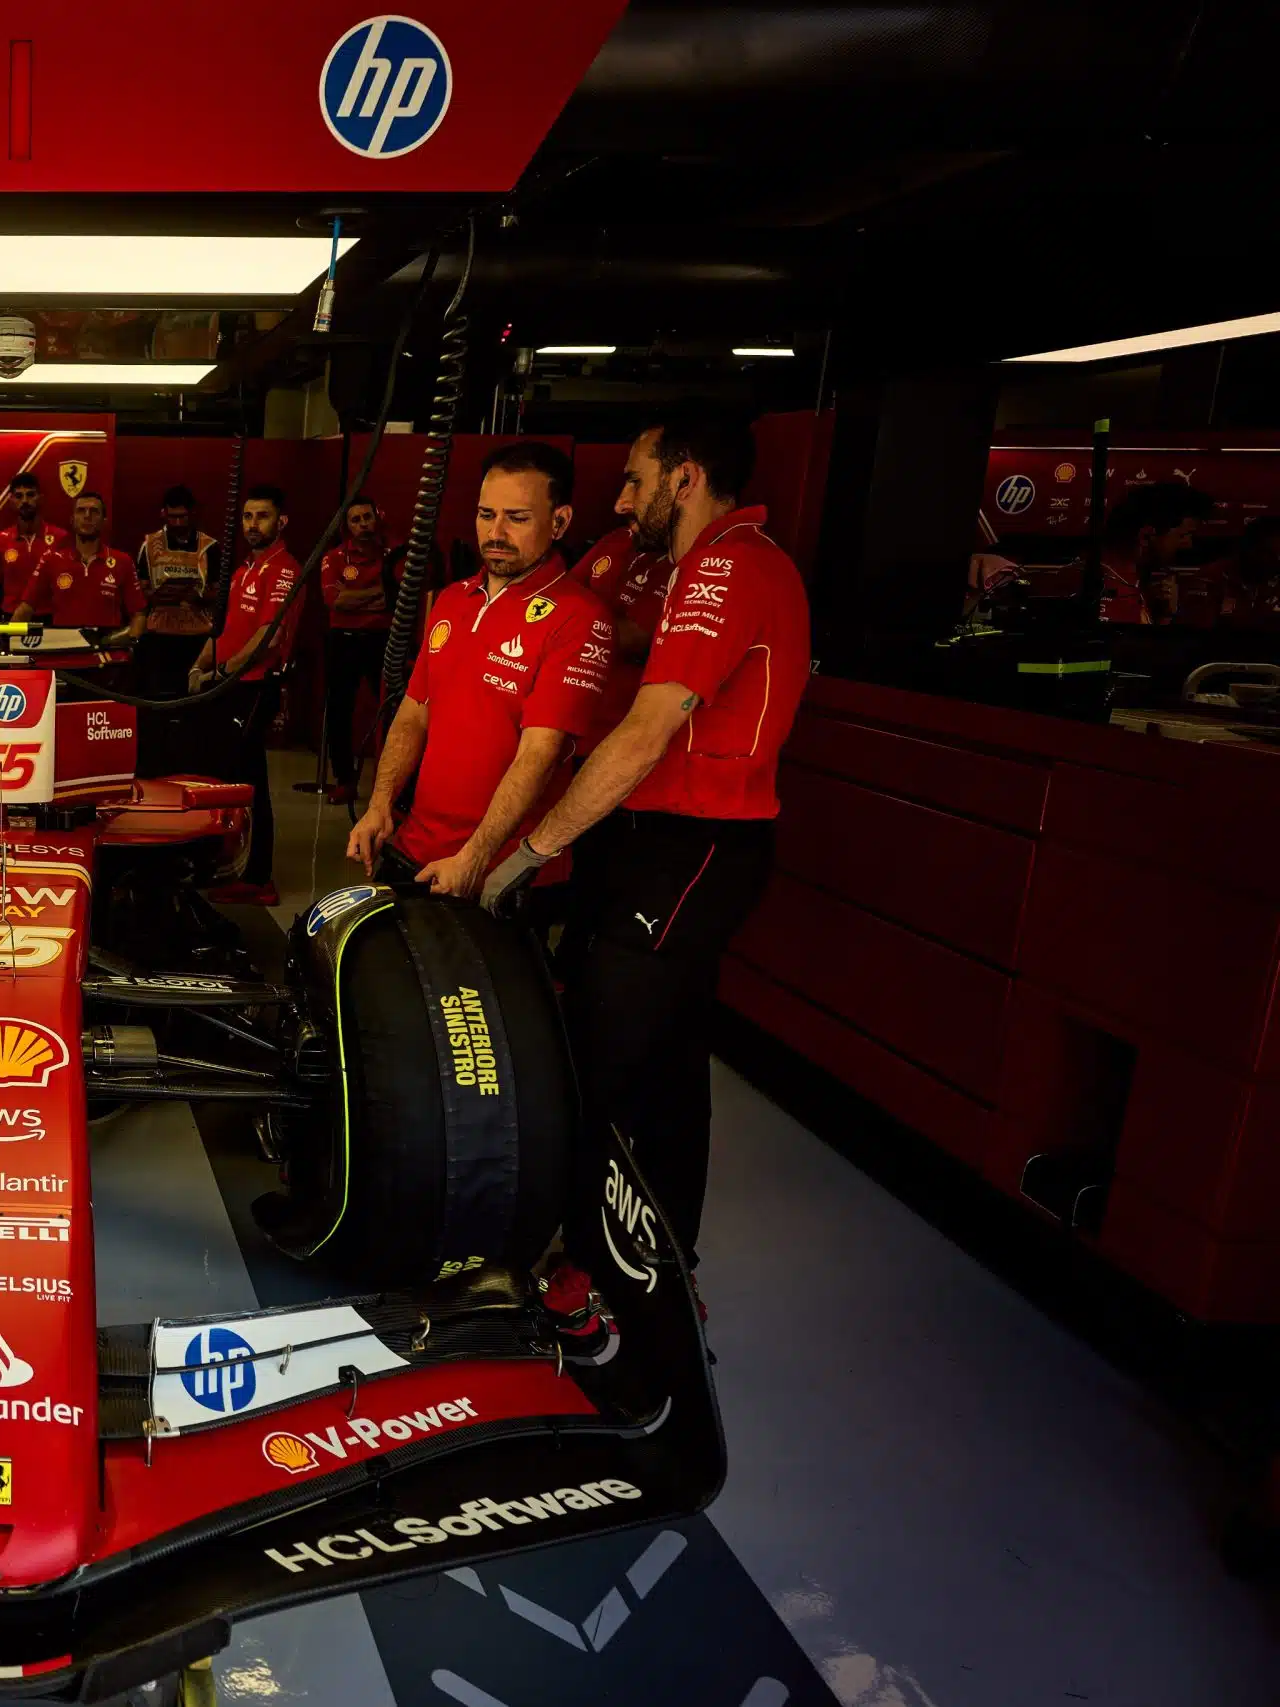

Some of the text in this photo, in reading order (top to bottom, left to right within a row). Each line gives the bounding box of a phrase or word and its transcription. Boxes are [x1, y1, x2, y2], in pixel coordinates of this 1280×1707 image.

[337, 19, 435, 156] hp
[1000, 476, 1032, 514] hp
[700, 557, 734, 570] aws
[685, 583, 728, 603] DXC
[592, 620, 613, 635] aws
[701, 611, 725, 624] MILLE
[670, 623, 718, 638] HCLSoftware
[486, 651, 529, 673] Santander
[580, 642, 611, 664] DXC
[483, 673, 518, 691] CEVA
[87, 711, 110, 726] HCL
[87, 727, 133, 741] Software
[134, 977, 230, 989] ECOPOL
[440, 995, 476, 1086] SINISTRO
[458, 986, 499, 1096] ANTERIORE
[605, 1159, 656, 1250] aws
[36, 1294, 71, 1303] LIVE FIT
[192, 1328, 253, 1412] hp
[305, 1396, 479, 1461] V-Power
